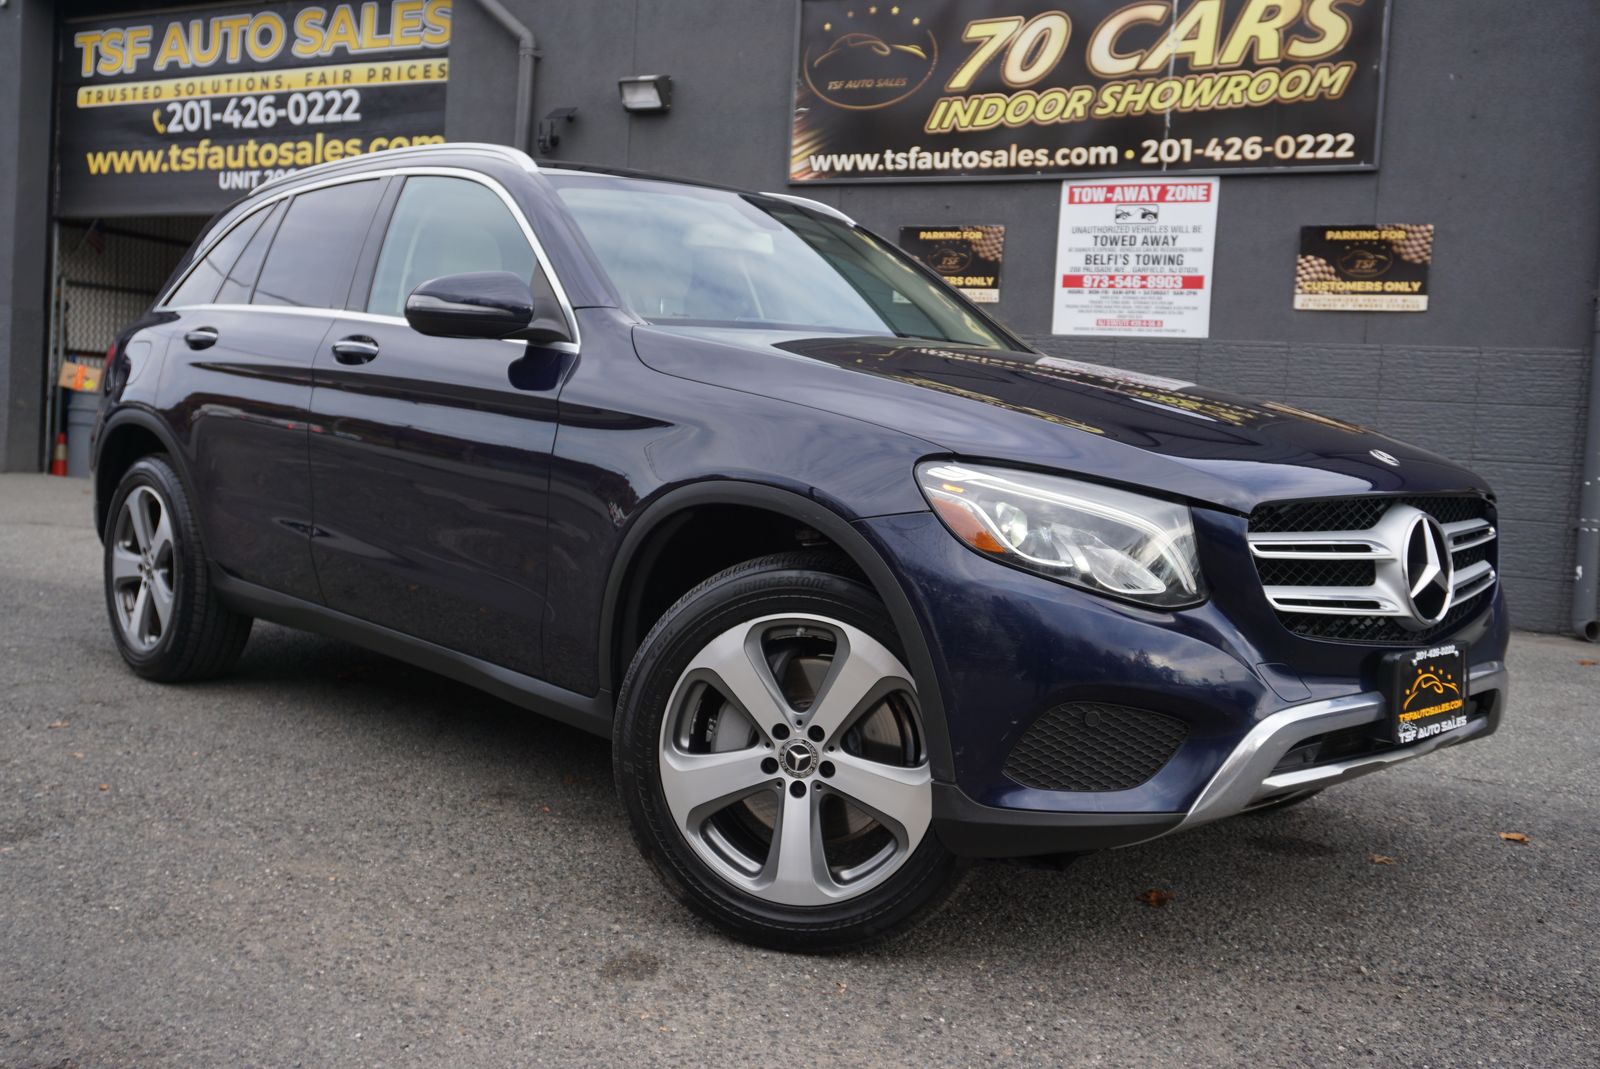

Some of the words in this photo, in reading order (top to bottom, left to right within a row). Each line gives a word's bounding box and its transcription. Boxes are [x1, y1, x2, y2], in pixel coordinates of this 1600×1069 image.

[74, 25, 153, 77] TSF
[153, 11, 287, 71] AUTO
[291, 0, 452, 58] SALES
[944, 10, 1072, 92] 70
[1086, 0, 1364, 78] CARS
[85, 86, 163, 104] TRUSTED
[173, 74, 292, 97] SOLUTIONS,
[305, 69, 353, 86] FAIR
[367, 63, 448, 82] PRICES
[827, 81, 845, 91] TSF
[845, 79, 874, 89] AUTO
[876, 78, 908, 88] SALES
[925, 85, 1096, 132] INDOOR
[1093, 61, 1357, 119] SHOWROOM
[166, 89, 361, 134] 201-426-0222
[86, 132, 445, 175] www.tsfautosalesco
[810, 143, 1118, 172] www.tsfautosales.com
[1140, 132, 1355, 164] 201-426-0222
[219, 170, 261, 190] UNIT
[1072, 185, 1161, 203] TOW-AWAY
[1165, 184, 1208, 201] ZONE
[919, 231, 961, 240] PARKING
[963, 231, 983, 240] FOR
[1071, 226, 1130, 234] UNAUTHORIZED
[1131, 225, 1168, 234] VEHICLES
[1171, 225, 1190, 233] WILL
[1192, 225, 1203, 233] BE
[1326, 230, 1379, 240] PARKING
[1381, 230, 1406, 240] FOR
[1093, 235, 1137, 247] TOWED
[1141, 235, 1178, 247] AWAY
[1085, 254, 1129, 266] BELFI'S
[1135, 254, 1184, 266] TOWING
[965, 276, 994, 286] ONLY
[1082, 275, 1183, 288] 973-546-8903
[1303, 281, 1382, 292] CUSTOMERS
[1384, 281, 1422, 292] ONLY
[1398, 729, 1417, 743] TSF
[1417, 723, 1441, 739] AUTO
[1441, 715, 1467, 732] SALES
